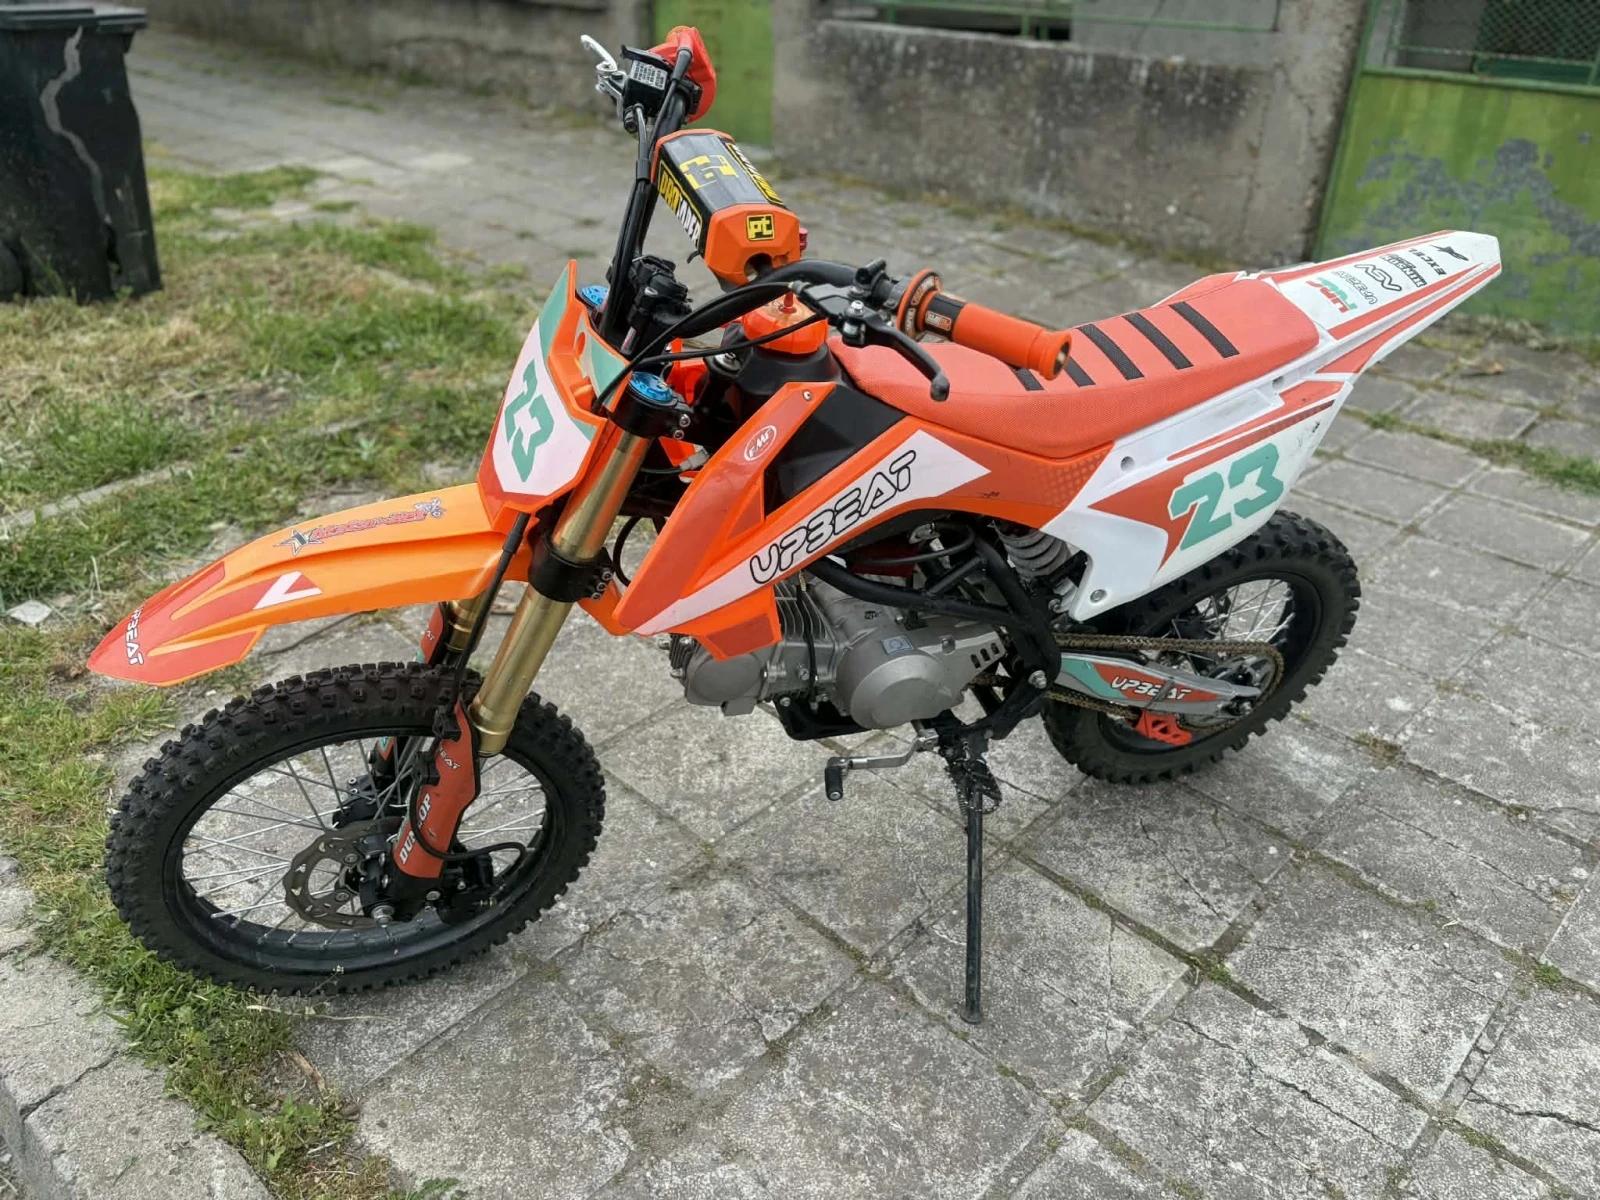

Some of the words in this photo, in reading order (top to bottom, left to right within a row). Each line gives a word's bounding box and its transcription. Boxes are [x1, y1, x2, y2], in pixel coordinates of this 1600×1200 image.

[1409, 248, 1446, 275] EXCEL
[505, 358, 555, 483] 23
[747, 427, 774, 459] FMF
[750, 450, 916, 584] UPBEAT
[1169, 442, 1284, 551] 23
